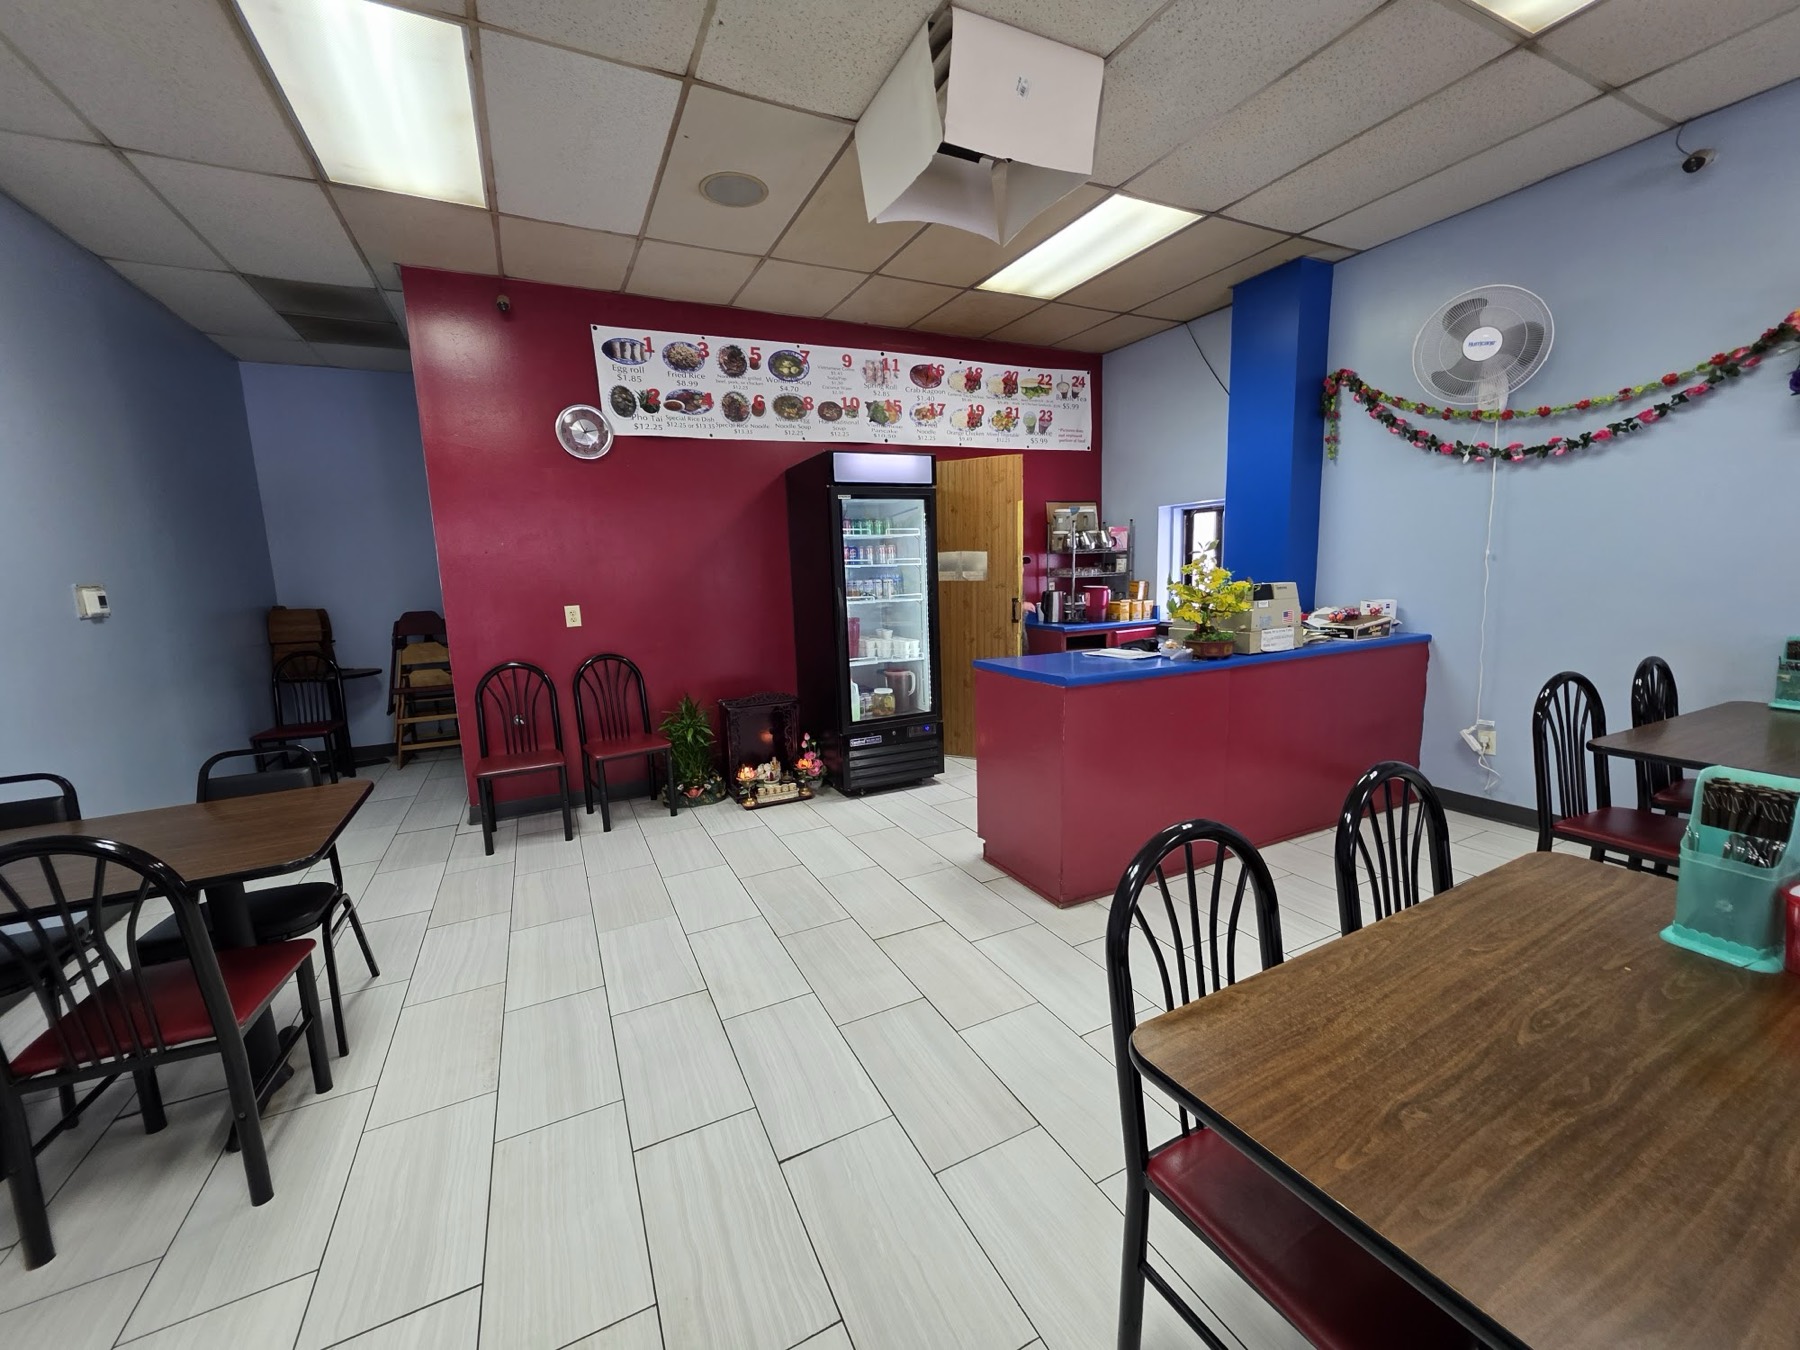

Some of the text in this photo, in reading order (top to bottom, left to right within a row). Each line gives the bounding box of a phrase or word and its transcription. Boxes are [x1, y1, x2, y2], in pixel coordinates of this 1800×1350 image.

[643, 337, 655, 353] 1
[696, 342, 710, 359] 3
[751, 347, 762, 362] 5
[800, 350, 810, 366] 7
[841, 354, 853, 368] 9
[612, 364, 645, 374] Egg roll
[882, 357, 900, 372] 11
[928, 363, 945, 377] 16
[617, 373, 643, 383] $1.85
[667, 371, 706, 380] Fried Rice
[1037, 374, 1052, 386] 22
[1072, 375, 1086, 388] 24
[676, 380, 699, 388] $8.99
[647, 388, 661, 405] 2
[753, 394, 766, 409] 6
[802, 397, 814, 410] 8
[841, 396, 860, 411] 10
[885, 399, 903, 413] 15
[929, 402, 946, 416] 17
[967, 403, 985, 418] 19
[631, 413, 648, 421] Pho
[1039, 409, 1053, 422] 23
[634, 422, 663, 431] $12.25
